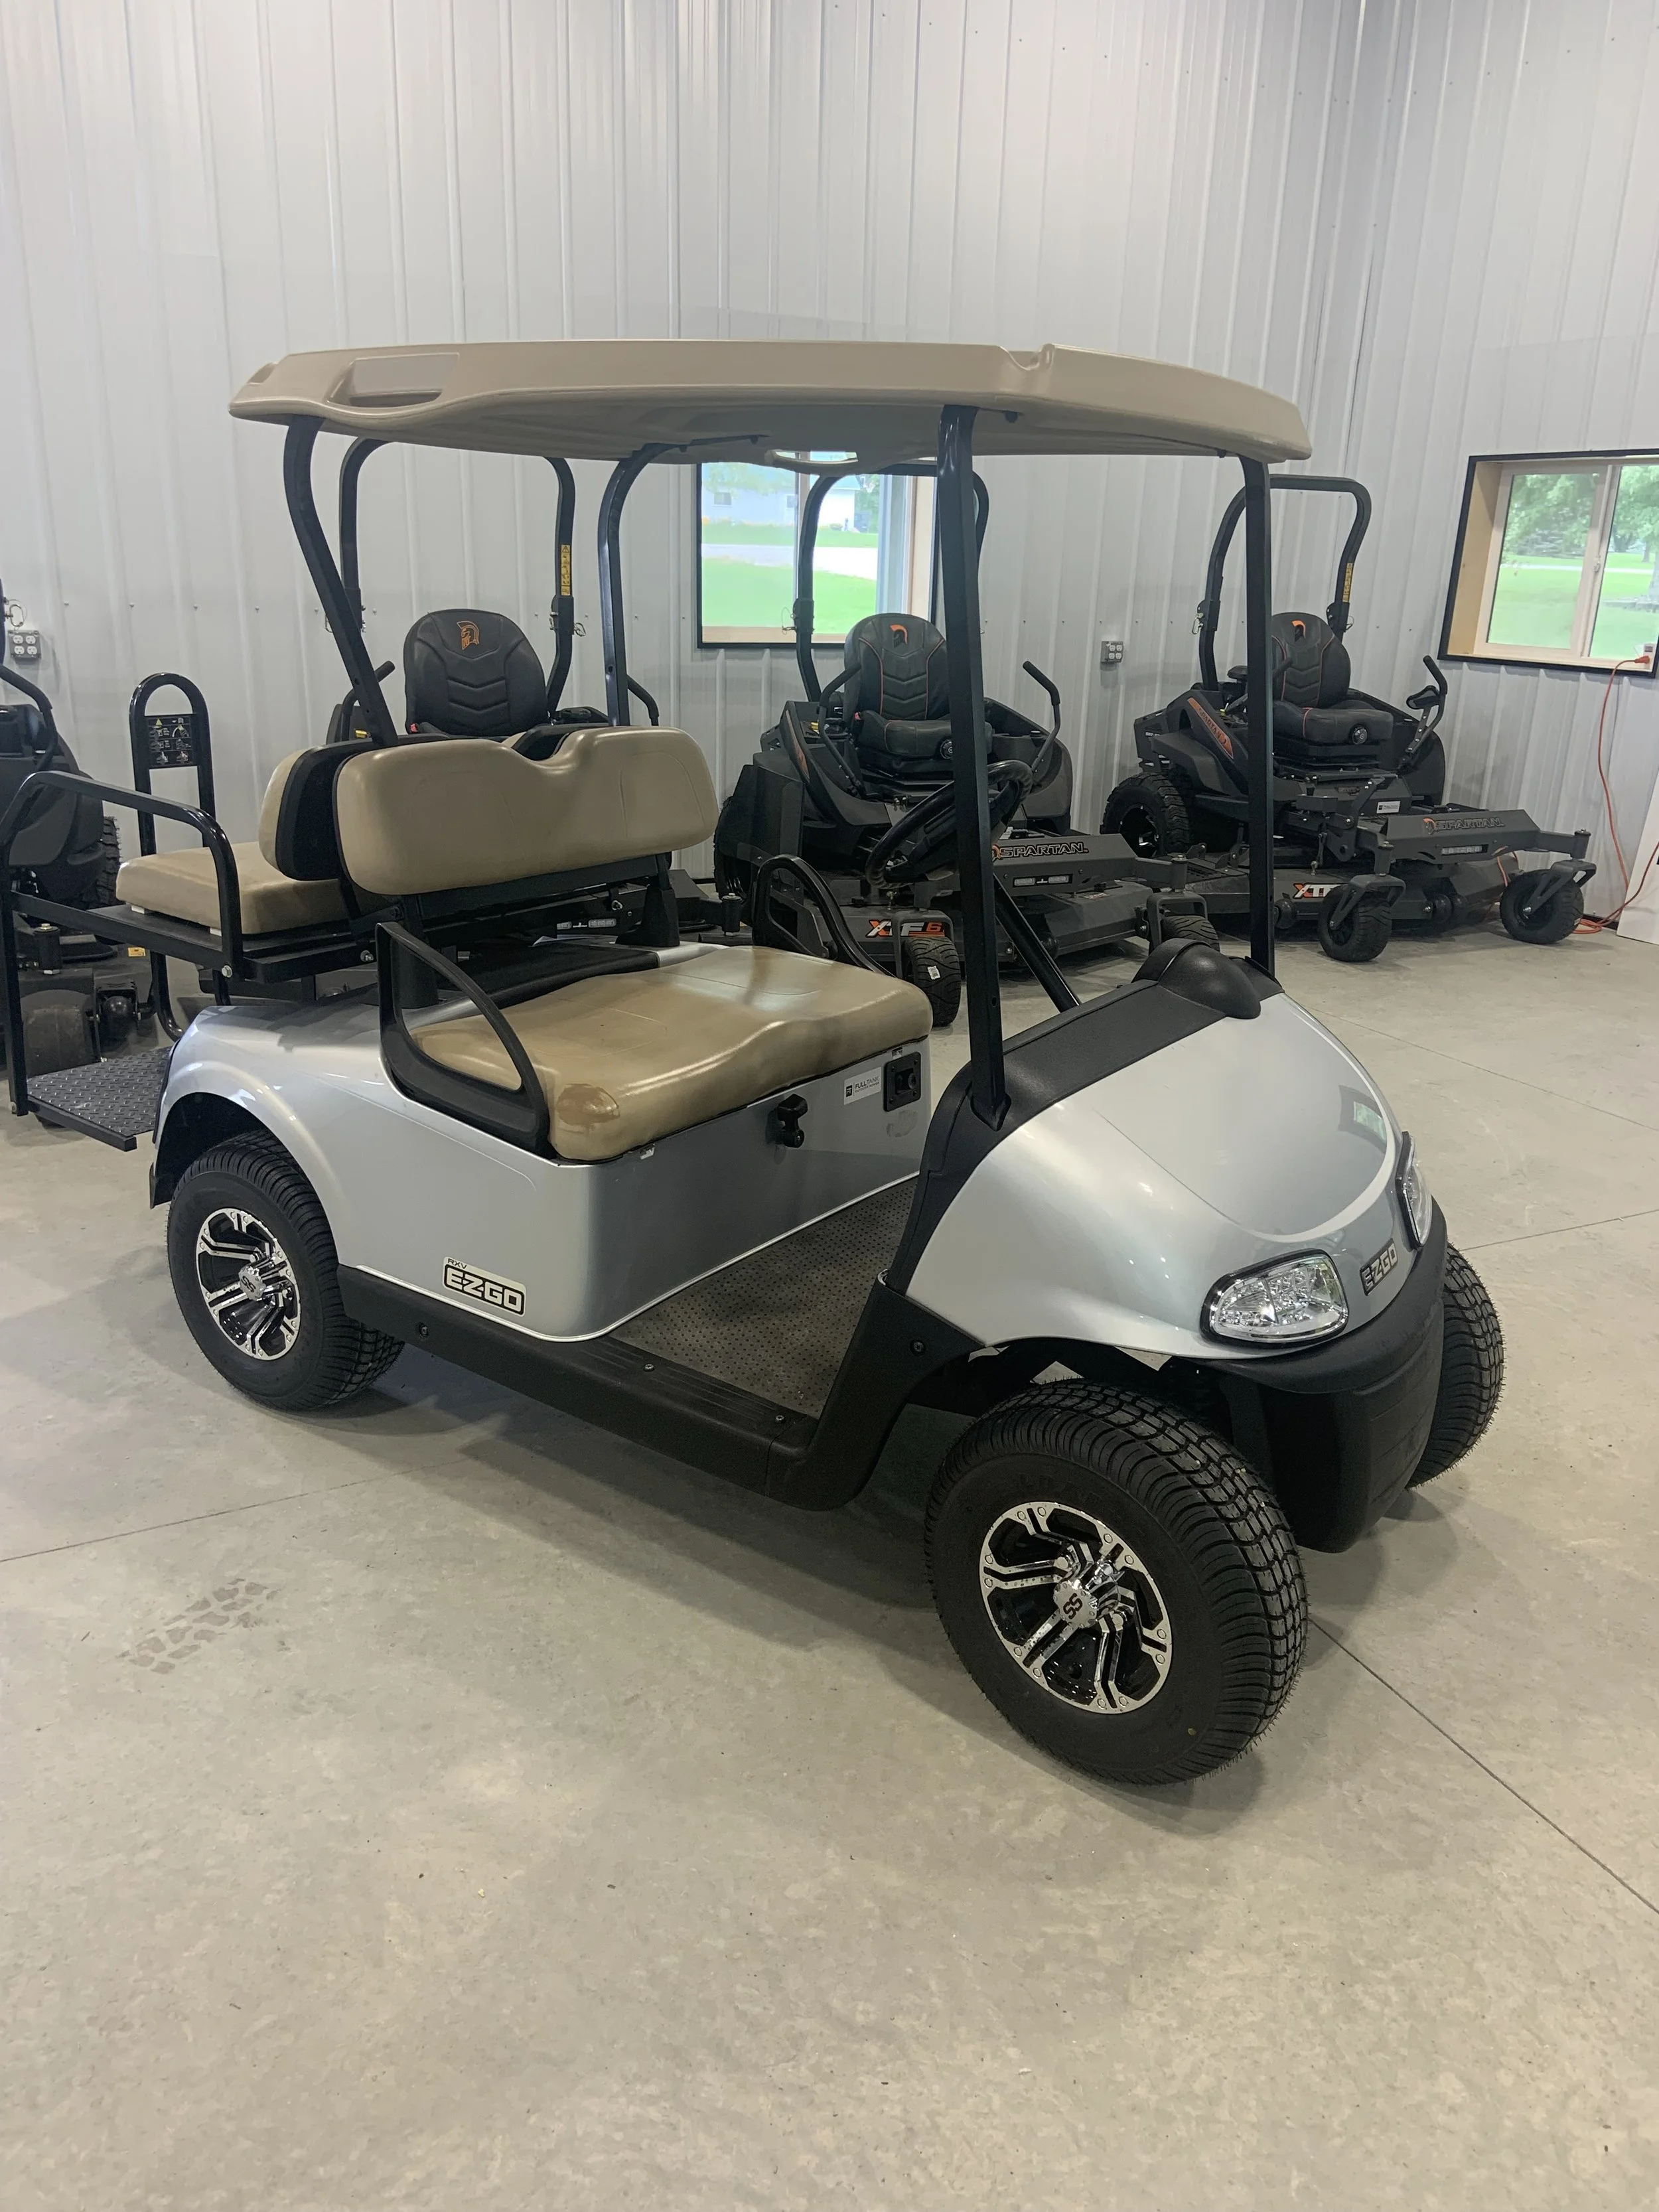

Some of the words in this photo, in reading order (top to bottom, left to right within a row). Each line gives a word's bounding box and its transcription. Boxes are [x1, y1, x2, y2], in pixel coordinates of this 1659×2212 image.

[1435, 817, 1501, 831] SPARTAN
[999, 842, 1084, 858] SPARTAN
[447, 1258, 467, 1270] RXV
[1361, 1242, 1398, 1293] EZGO
[446, 1266, 523, 1313] EZGO
[1062, 1592, 1083, 1620] SS
